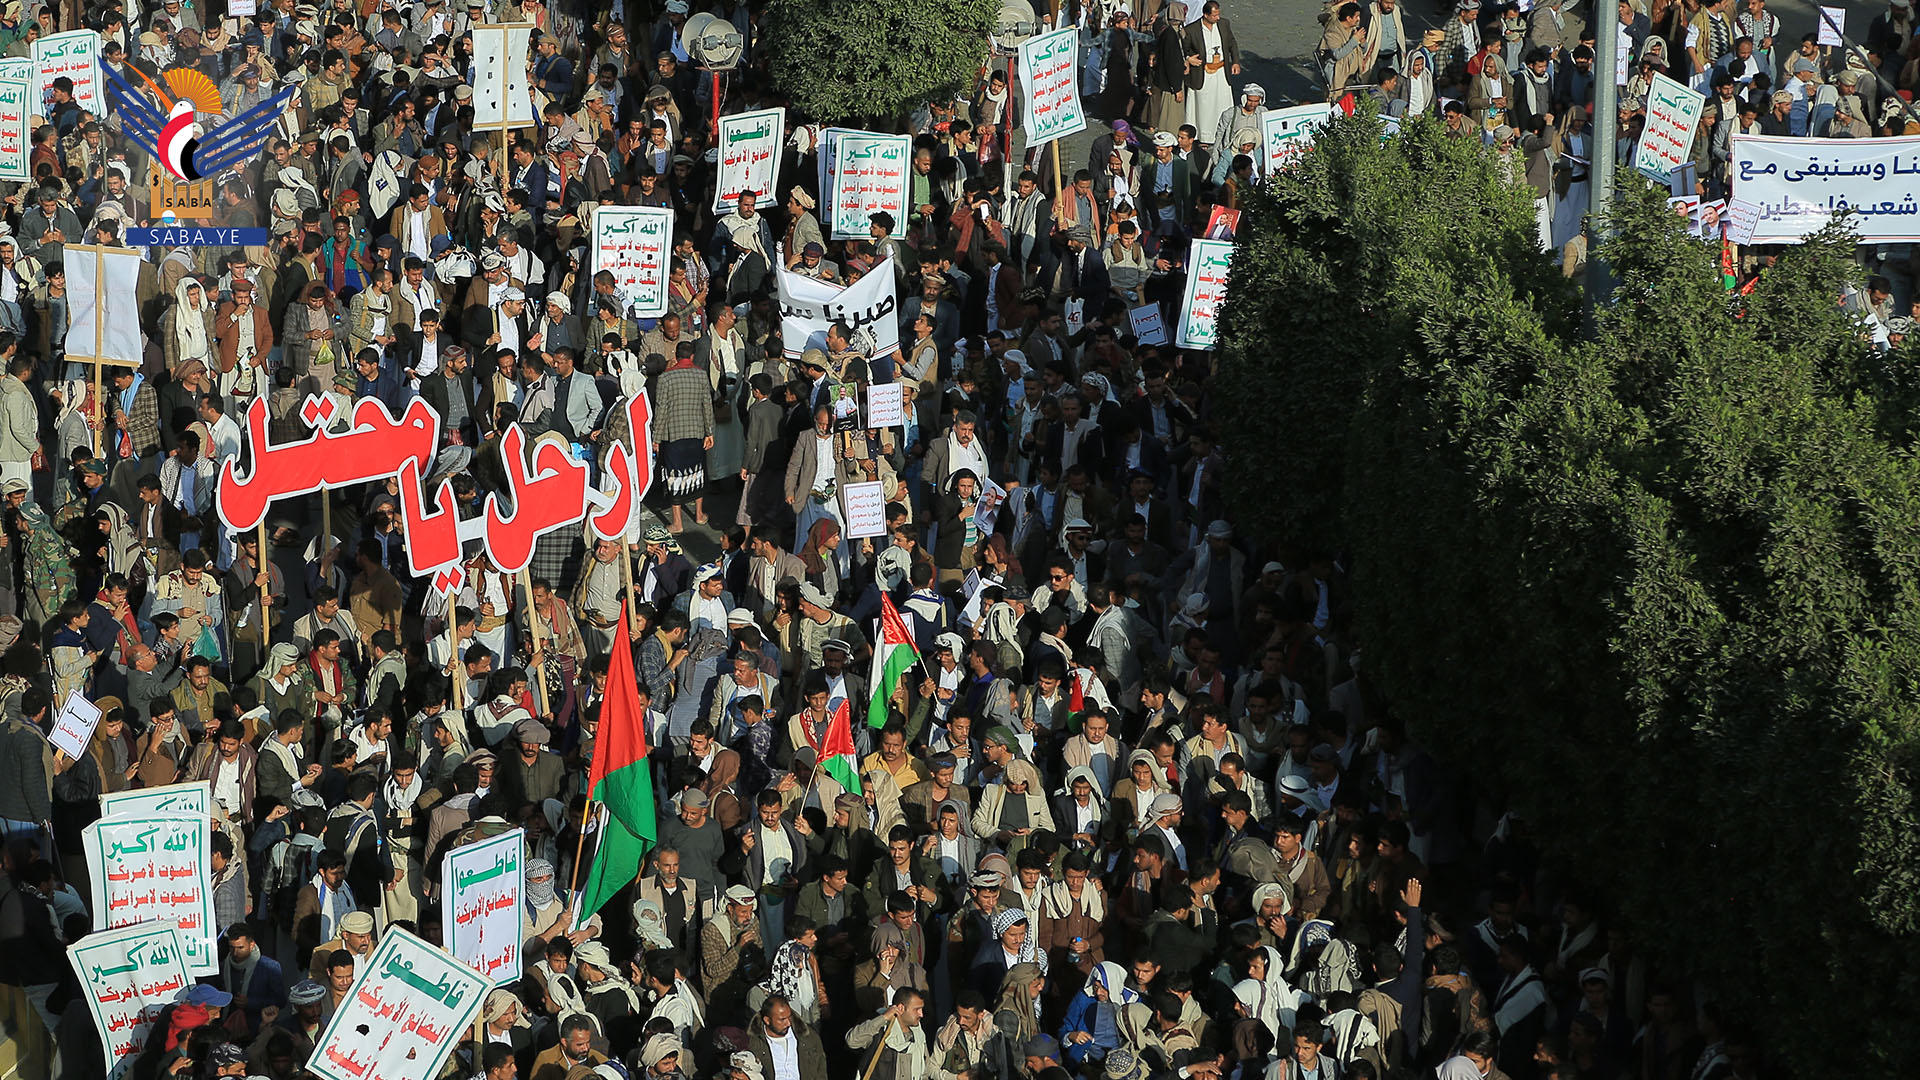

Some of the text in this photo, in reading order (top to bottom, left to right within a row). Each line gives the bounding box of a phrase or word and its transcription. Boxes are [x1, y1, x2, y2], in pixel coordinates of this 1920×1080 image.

[41, 40, 92, 62] الله أكبر
[1032, 35, 1073, 67] الله أكبر
[71, 59, 92, 71] الموت
[1057, 56, 1072, 72] الموت
[1058, 73, 1072, 90] الموت
[1654, 91, 1697, 117] الله أكبر
[1, 112, 21, 123] المو
[1672, 120, 1691, 133] الموت
[1, 128, 21, 139] المو
[726, 119, 770, 147] قاطعوا
[1668, 135, 1687, 149] الموت
[752, 145, 773, 165] البضائع
[845, 141, 880, 163] أكبر
[881, 144, 904, 159] الله
[0, 157, 21, 169] النص
[745, 166, 749, 180] و
[877, 166, 902, 178] الموت
[1739, 156, 1920, 182] نا وسنبقى مع
[876, 183, 902, 195] الموت
[841, 196, 863, 211] اليهود
[881, 199, 901, 210] اللعنة
[1856, 192, 1918, 221] شعب
[601, 215, 664, 238] الله أكبر
[635, 242, 662, 254] الموت
[634, 259, 661, 271] الموت
[1201, 252, 1233, 270] كبر
[220, 391, 650, 595] ارحل يا محتل
[67, 705, 93, 728] ارحل
[58, 722, 84, 746] يا محتل
[106, 824, 197, 862] الله أكبر
[107, 858, 197, 884] الموت لأمريكا
[455, 848, 517, 897] قاطعوا
[109, 887, 200, 911] الموت لإسرائيل
[456, 887, 517, 929] البضائع الأمريكية
[479, 924, 484, 944] و
[91, 940, 177, 986] الله أكبر
[379, 943, 470, 1010] قاطعوا
[96, 973, 184, 1004] الموت لأمريكا
[356, 978, 451, 1047] البضائع الأمريكية
[379, 1030, 393, 1052] و
